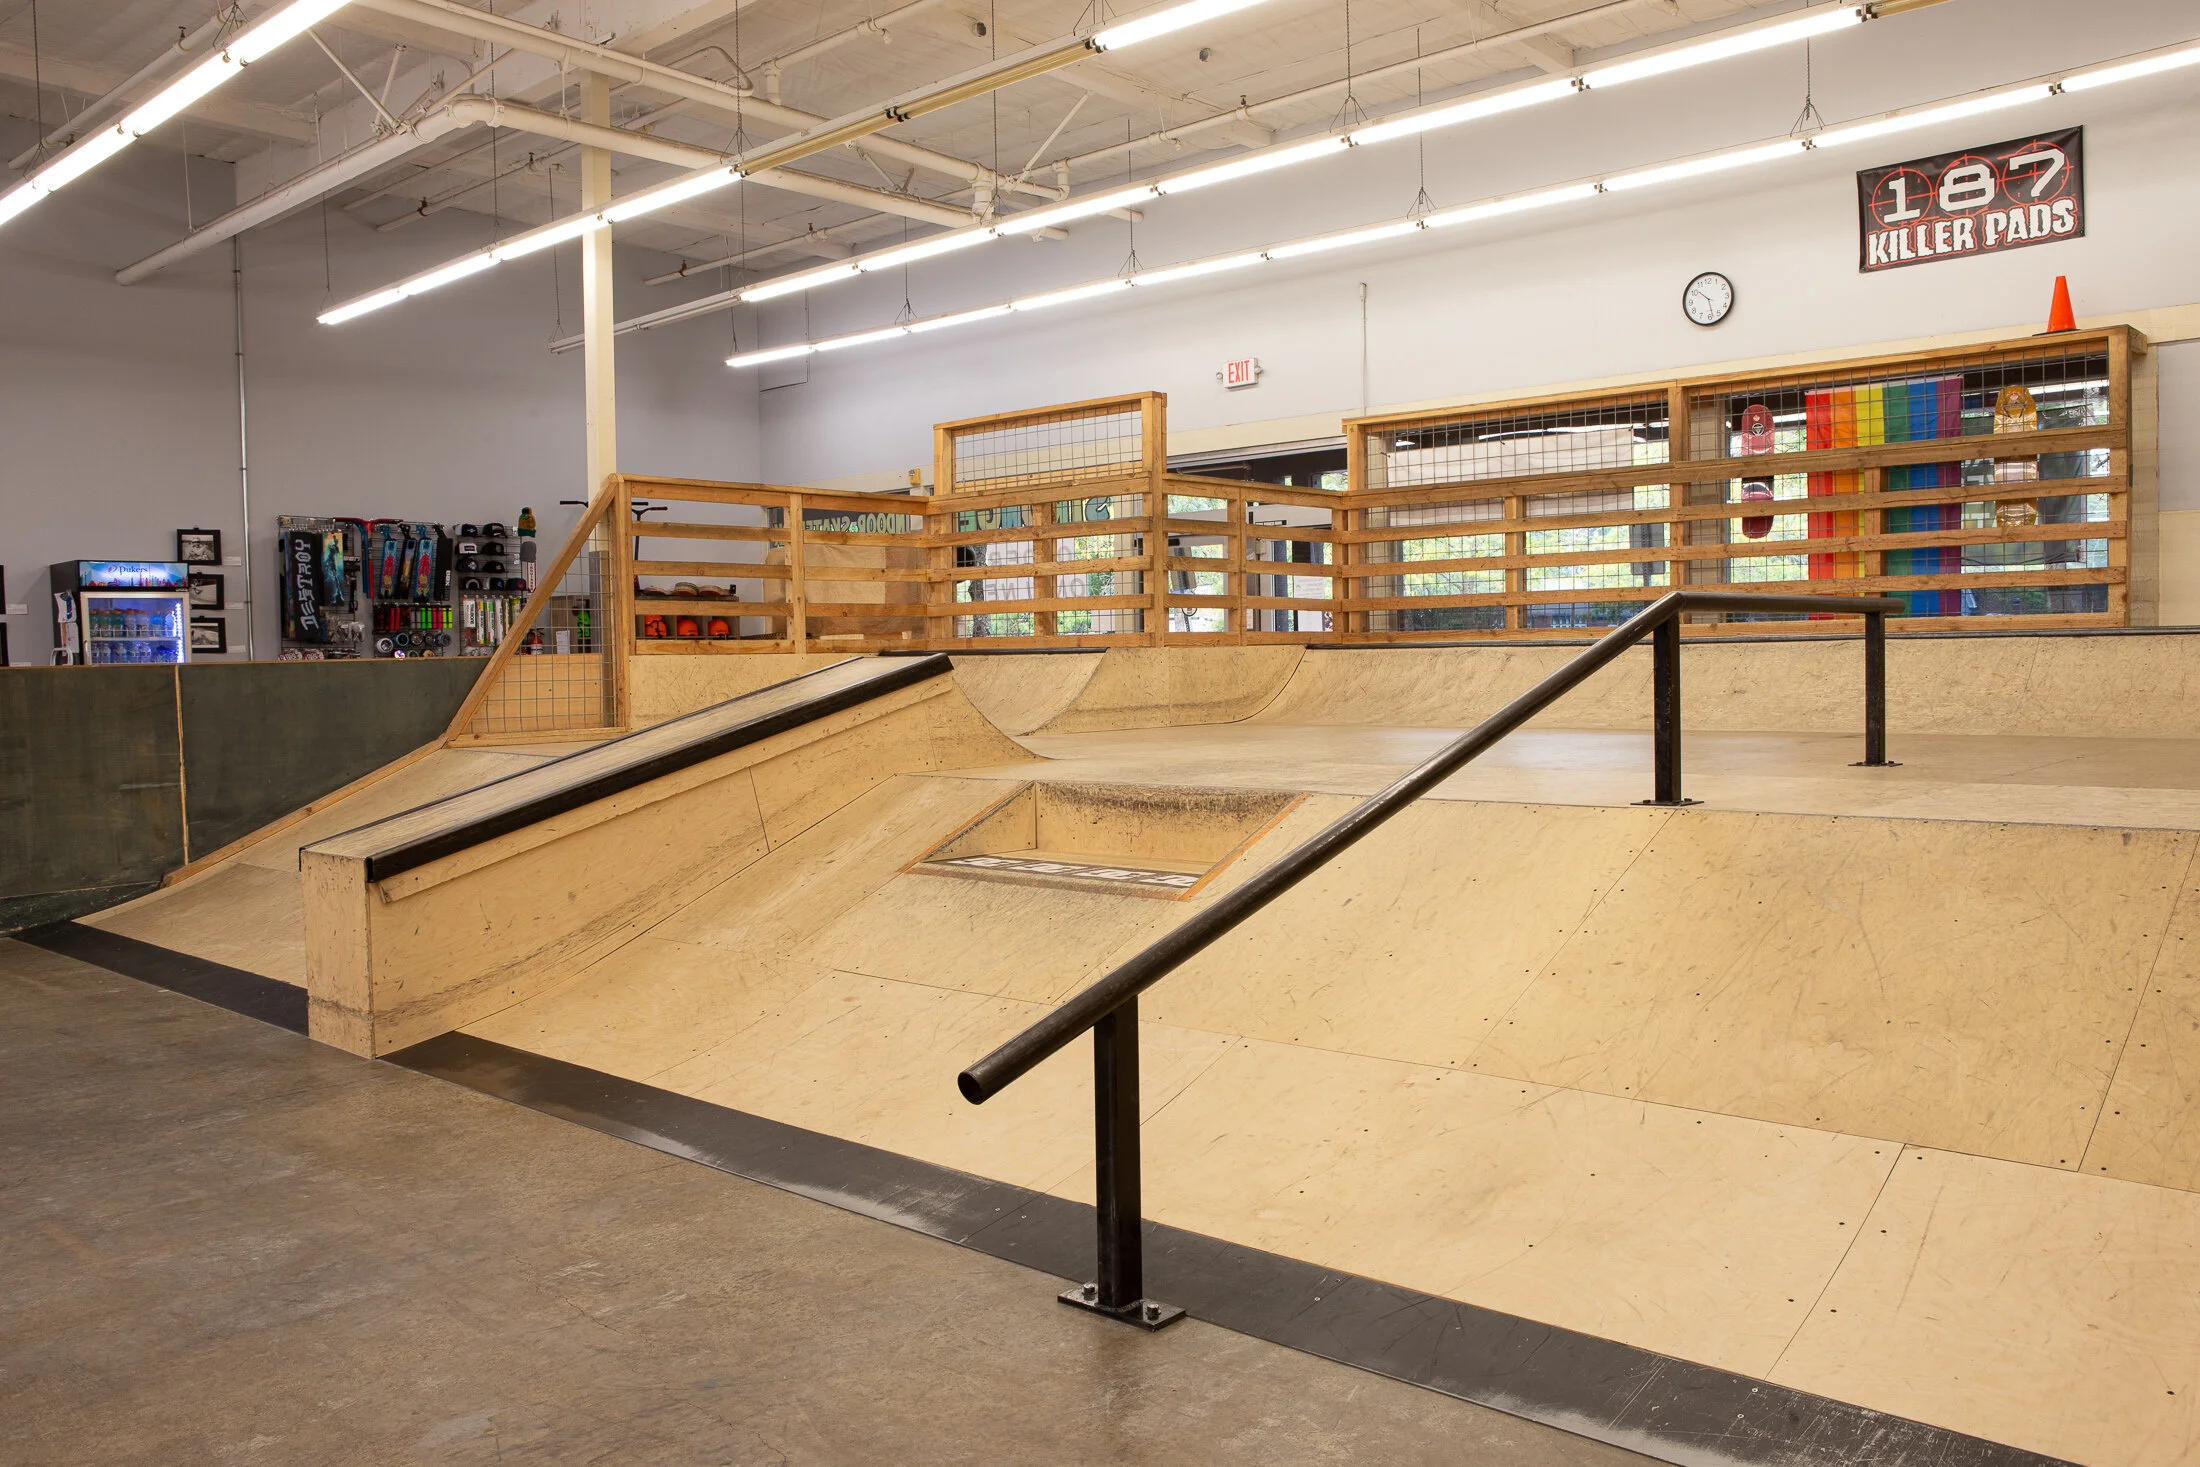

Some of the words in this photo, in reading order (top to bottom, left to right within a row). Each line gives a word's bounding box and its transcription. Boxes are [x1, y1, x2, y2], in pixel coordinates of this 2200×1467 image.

[1884, 148, 2065, 223] 187
[1867, 216, 1976, 266] KILLER
[1984, 198, 2075, 246] PADS
[1228, 360, 1250, 384] EXIT
[295, 539, 319, 631] DESTROY
